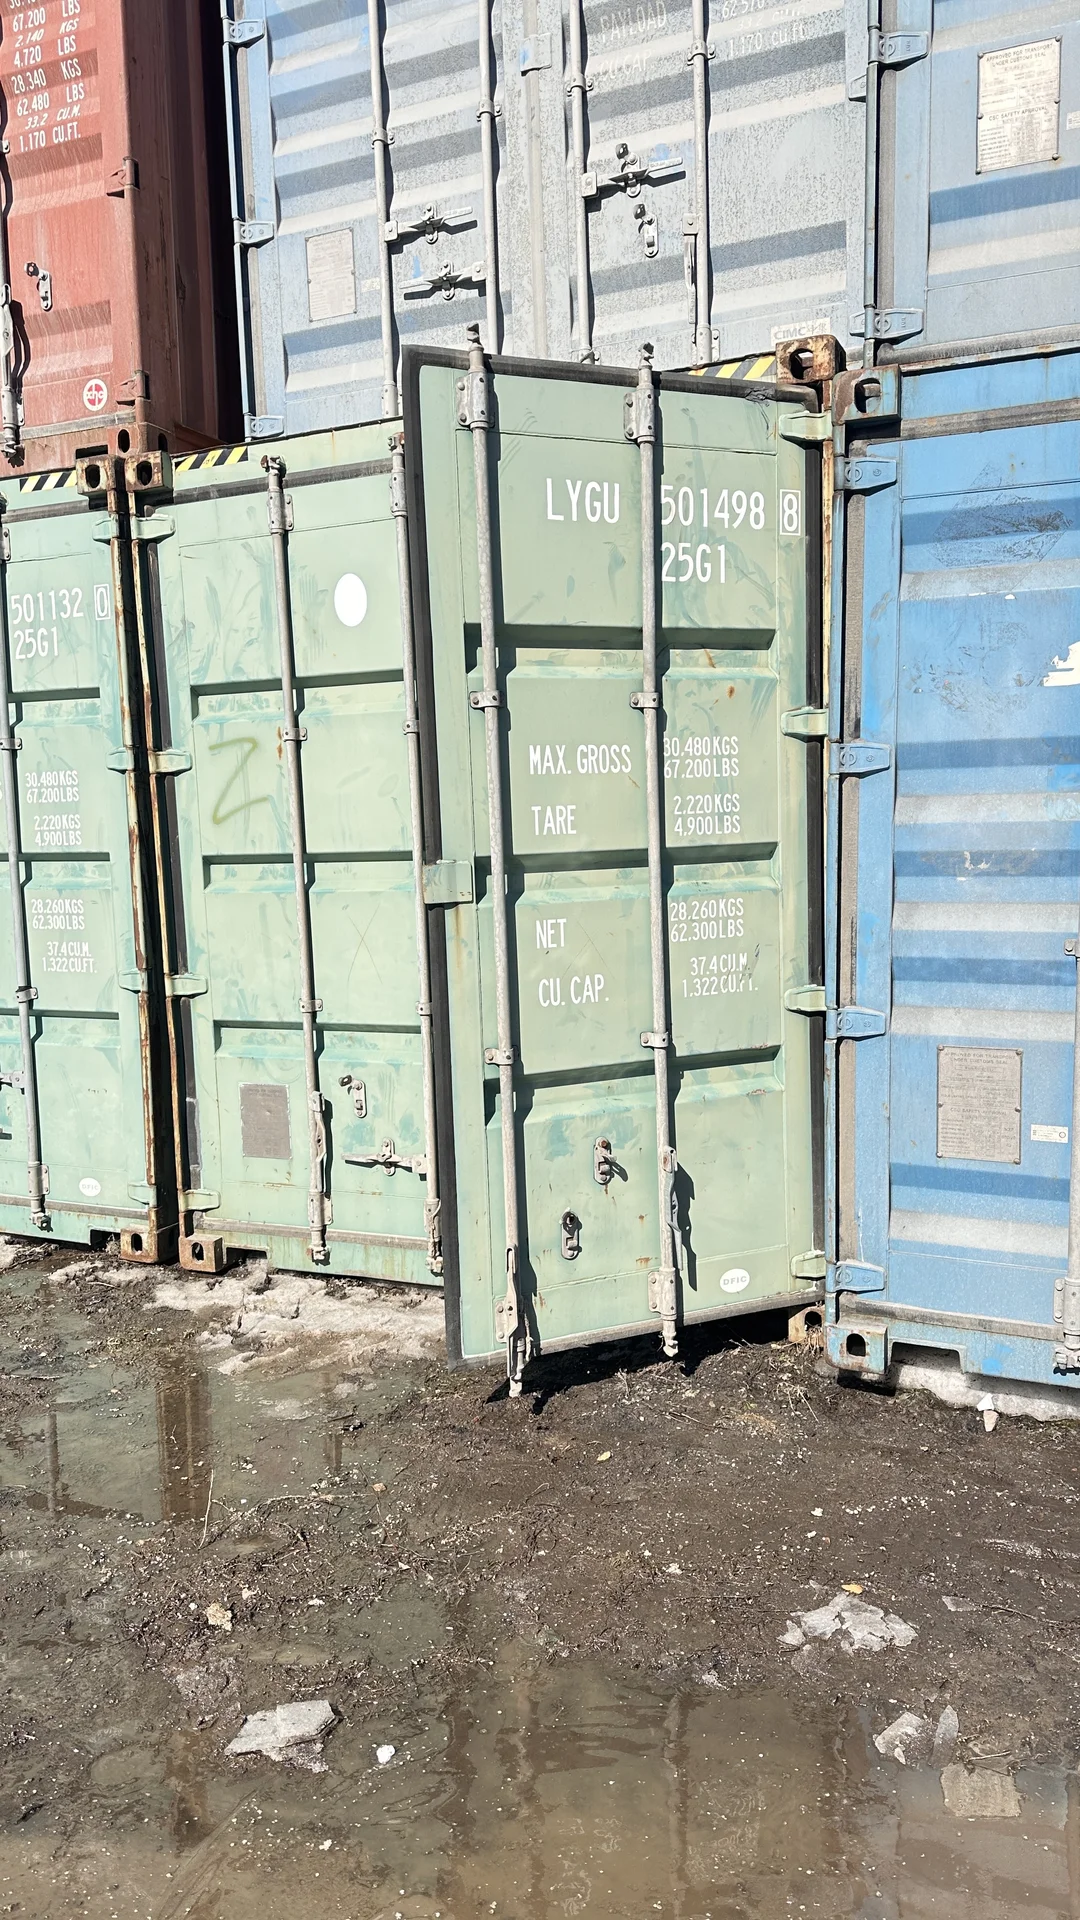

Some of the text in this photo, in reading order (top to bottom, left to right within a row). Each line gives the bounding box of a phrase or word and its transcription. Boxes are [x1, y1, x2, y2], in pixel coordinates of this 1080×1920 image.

[13, 0, 81, 32] 67.200 LBS
[15, 18, 79, 48] 2.140 KGS
[14, 35, 77, 68] 4.720 LBS
[11, 58, 82, 94] 28.340 KGS
[16, 83, 85, 117] 62.480 LBS
[25, 113, 48, 130] 33.2
[19, 130, 46, 152] 1.170
[774, 326, 805, 340] CIMC
[546, 477, 620, 524] LYGU
[660, 484, 799, 534] 501498 8
[660, 542, 726, 584] 25G1
[11, 587, 84, 624] 501132
[14, 626, 59, 660] 25G1
[529, 744, 632, 775] MAX. GROSS
[531, 804, 577, 835] TARE
[535, 918, 567, 949] NET
[570, 974, 609, 1004] CAP.
[723, 1275, 747, 1286] DFIC
